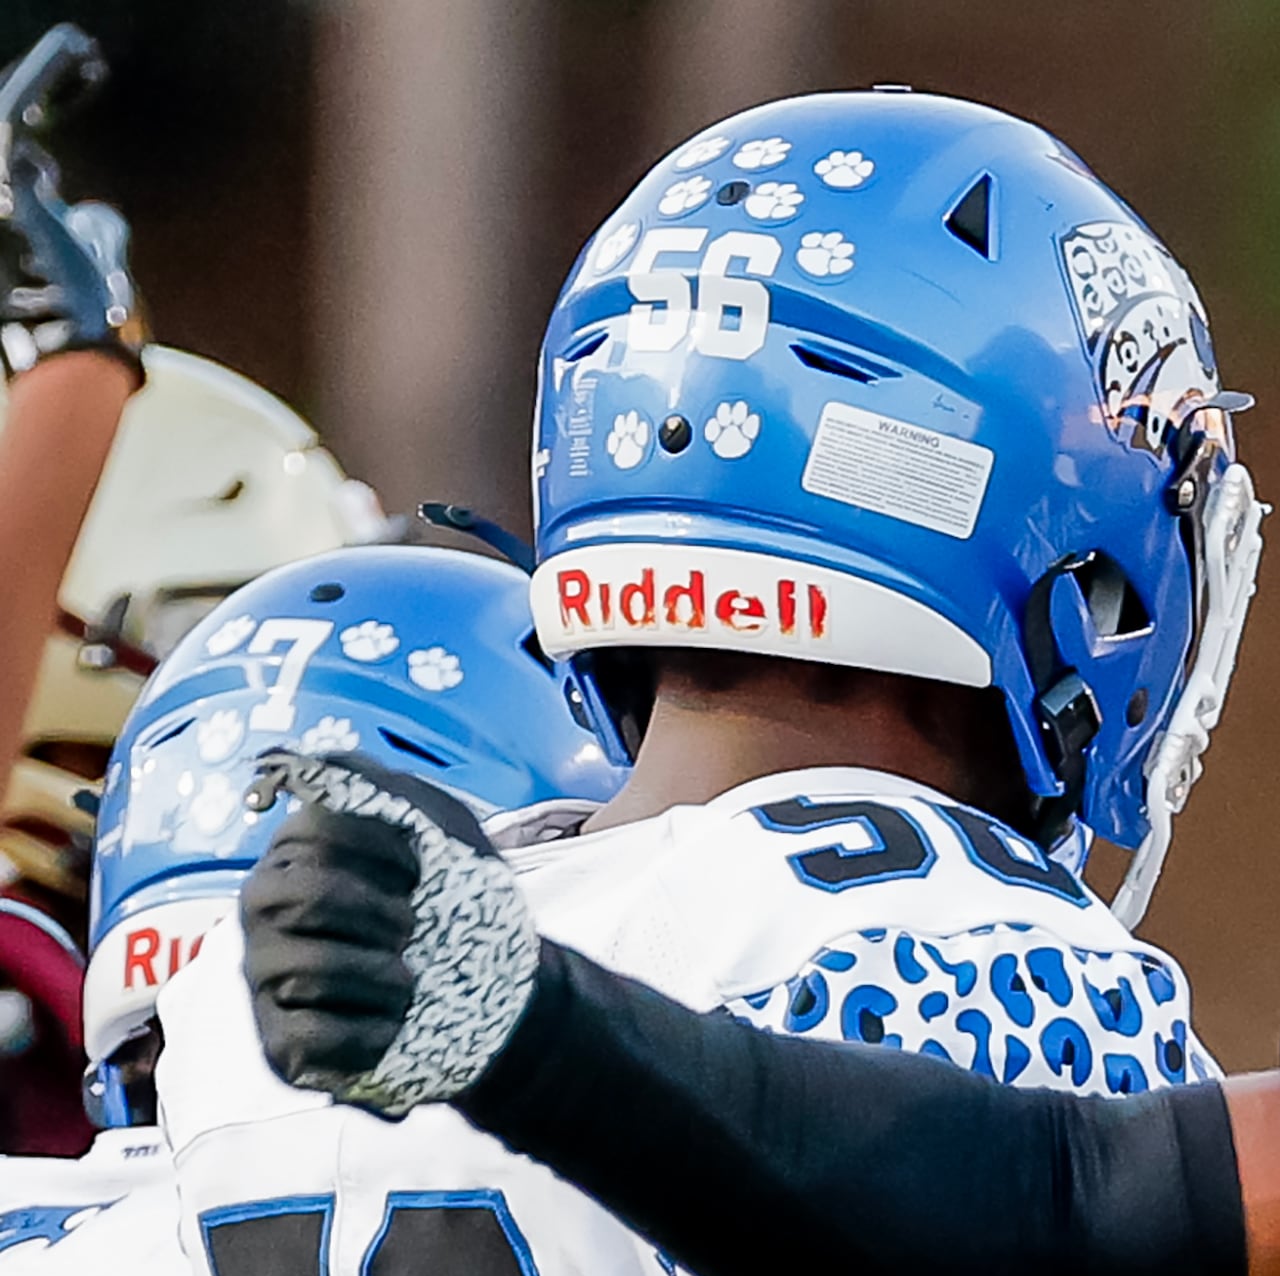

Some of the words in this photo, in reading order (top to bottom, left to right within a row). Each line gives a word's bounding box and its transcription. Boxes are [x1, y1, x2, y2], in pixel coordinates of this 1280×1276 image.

[627, 228, 783, 362] 56
[878, 420, 941, 449] WARNING
[556, 567, 829, 641] Riddell
[248, 617, 334, 732] 7
